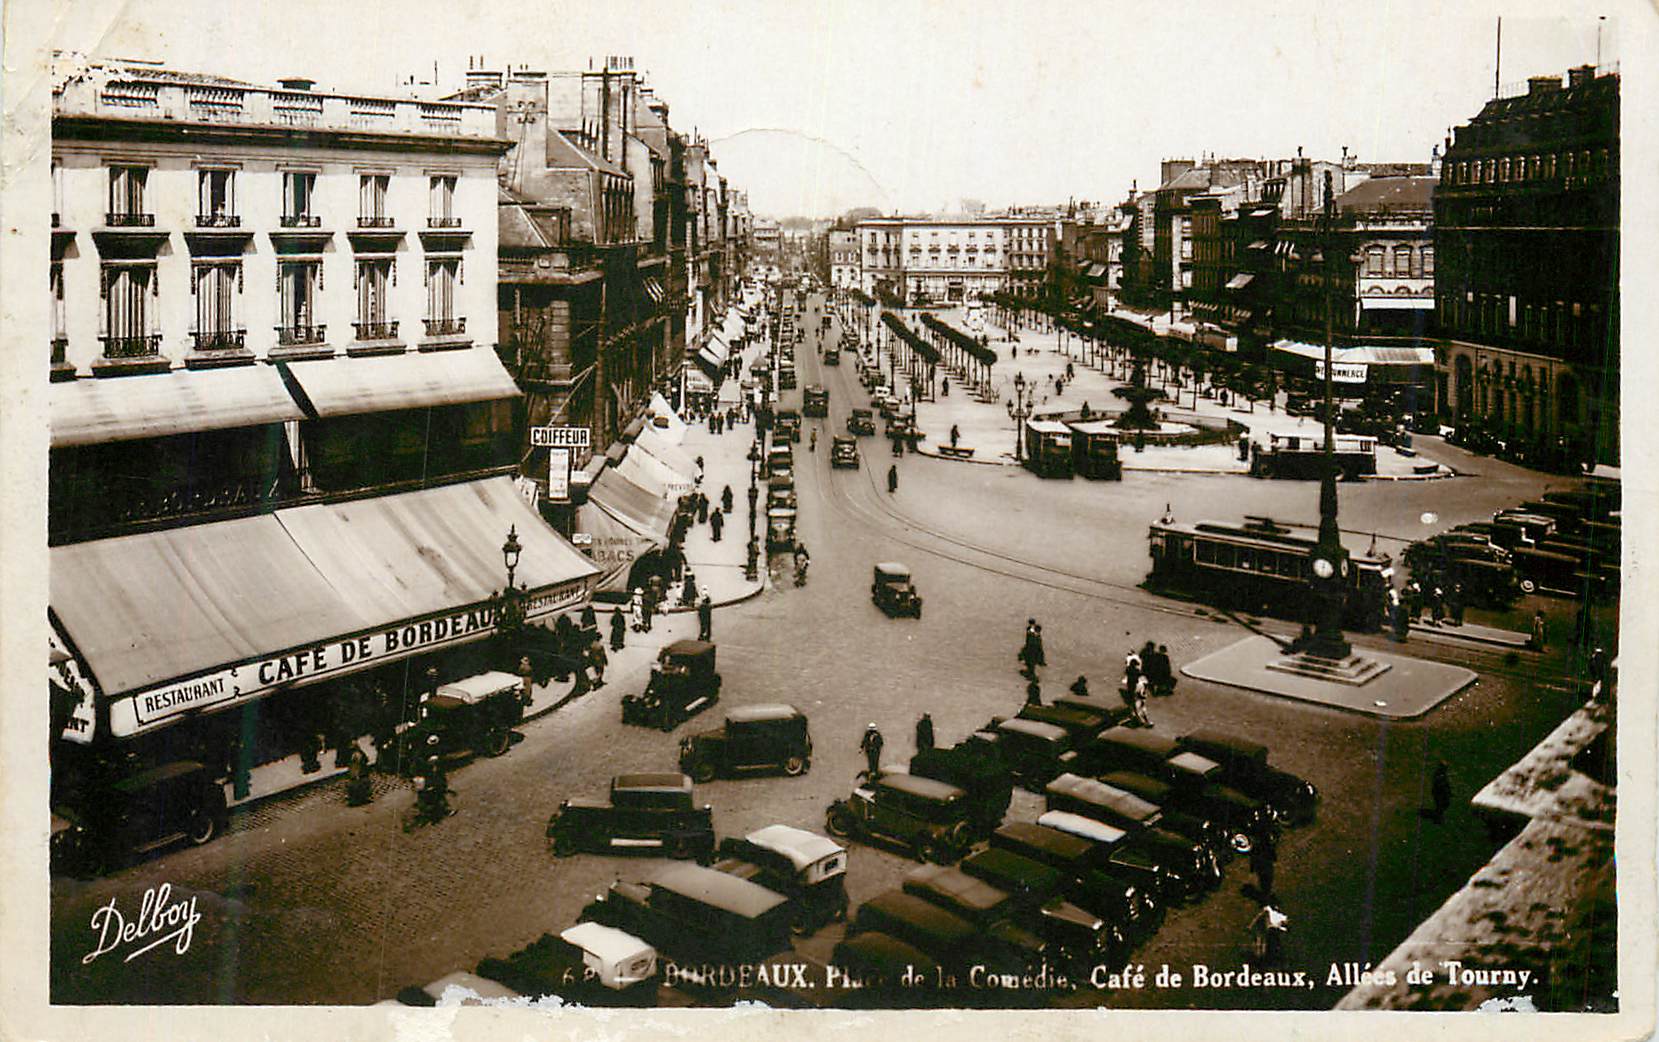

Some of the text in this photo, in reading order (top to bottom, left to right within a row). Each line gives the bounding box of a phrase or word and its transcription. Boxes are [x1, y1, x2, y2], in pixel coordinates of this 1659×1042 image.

[533, 429, 588, 445] COIFFEUR
[342, 636, 372, 663] DE
[145, 678, 226, 713] RESTAURANT
